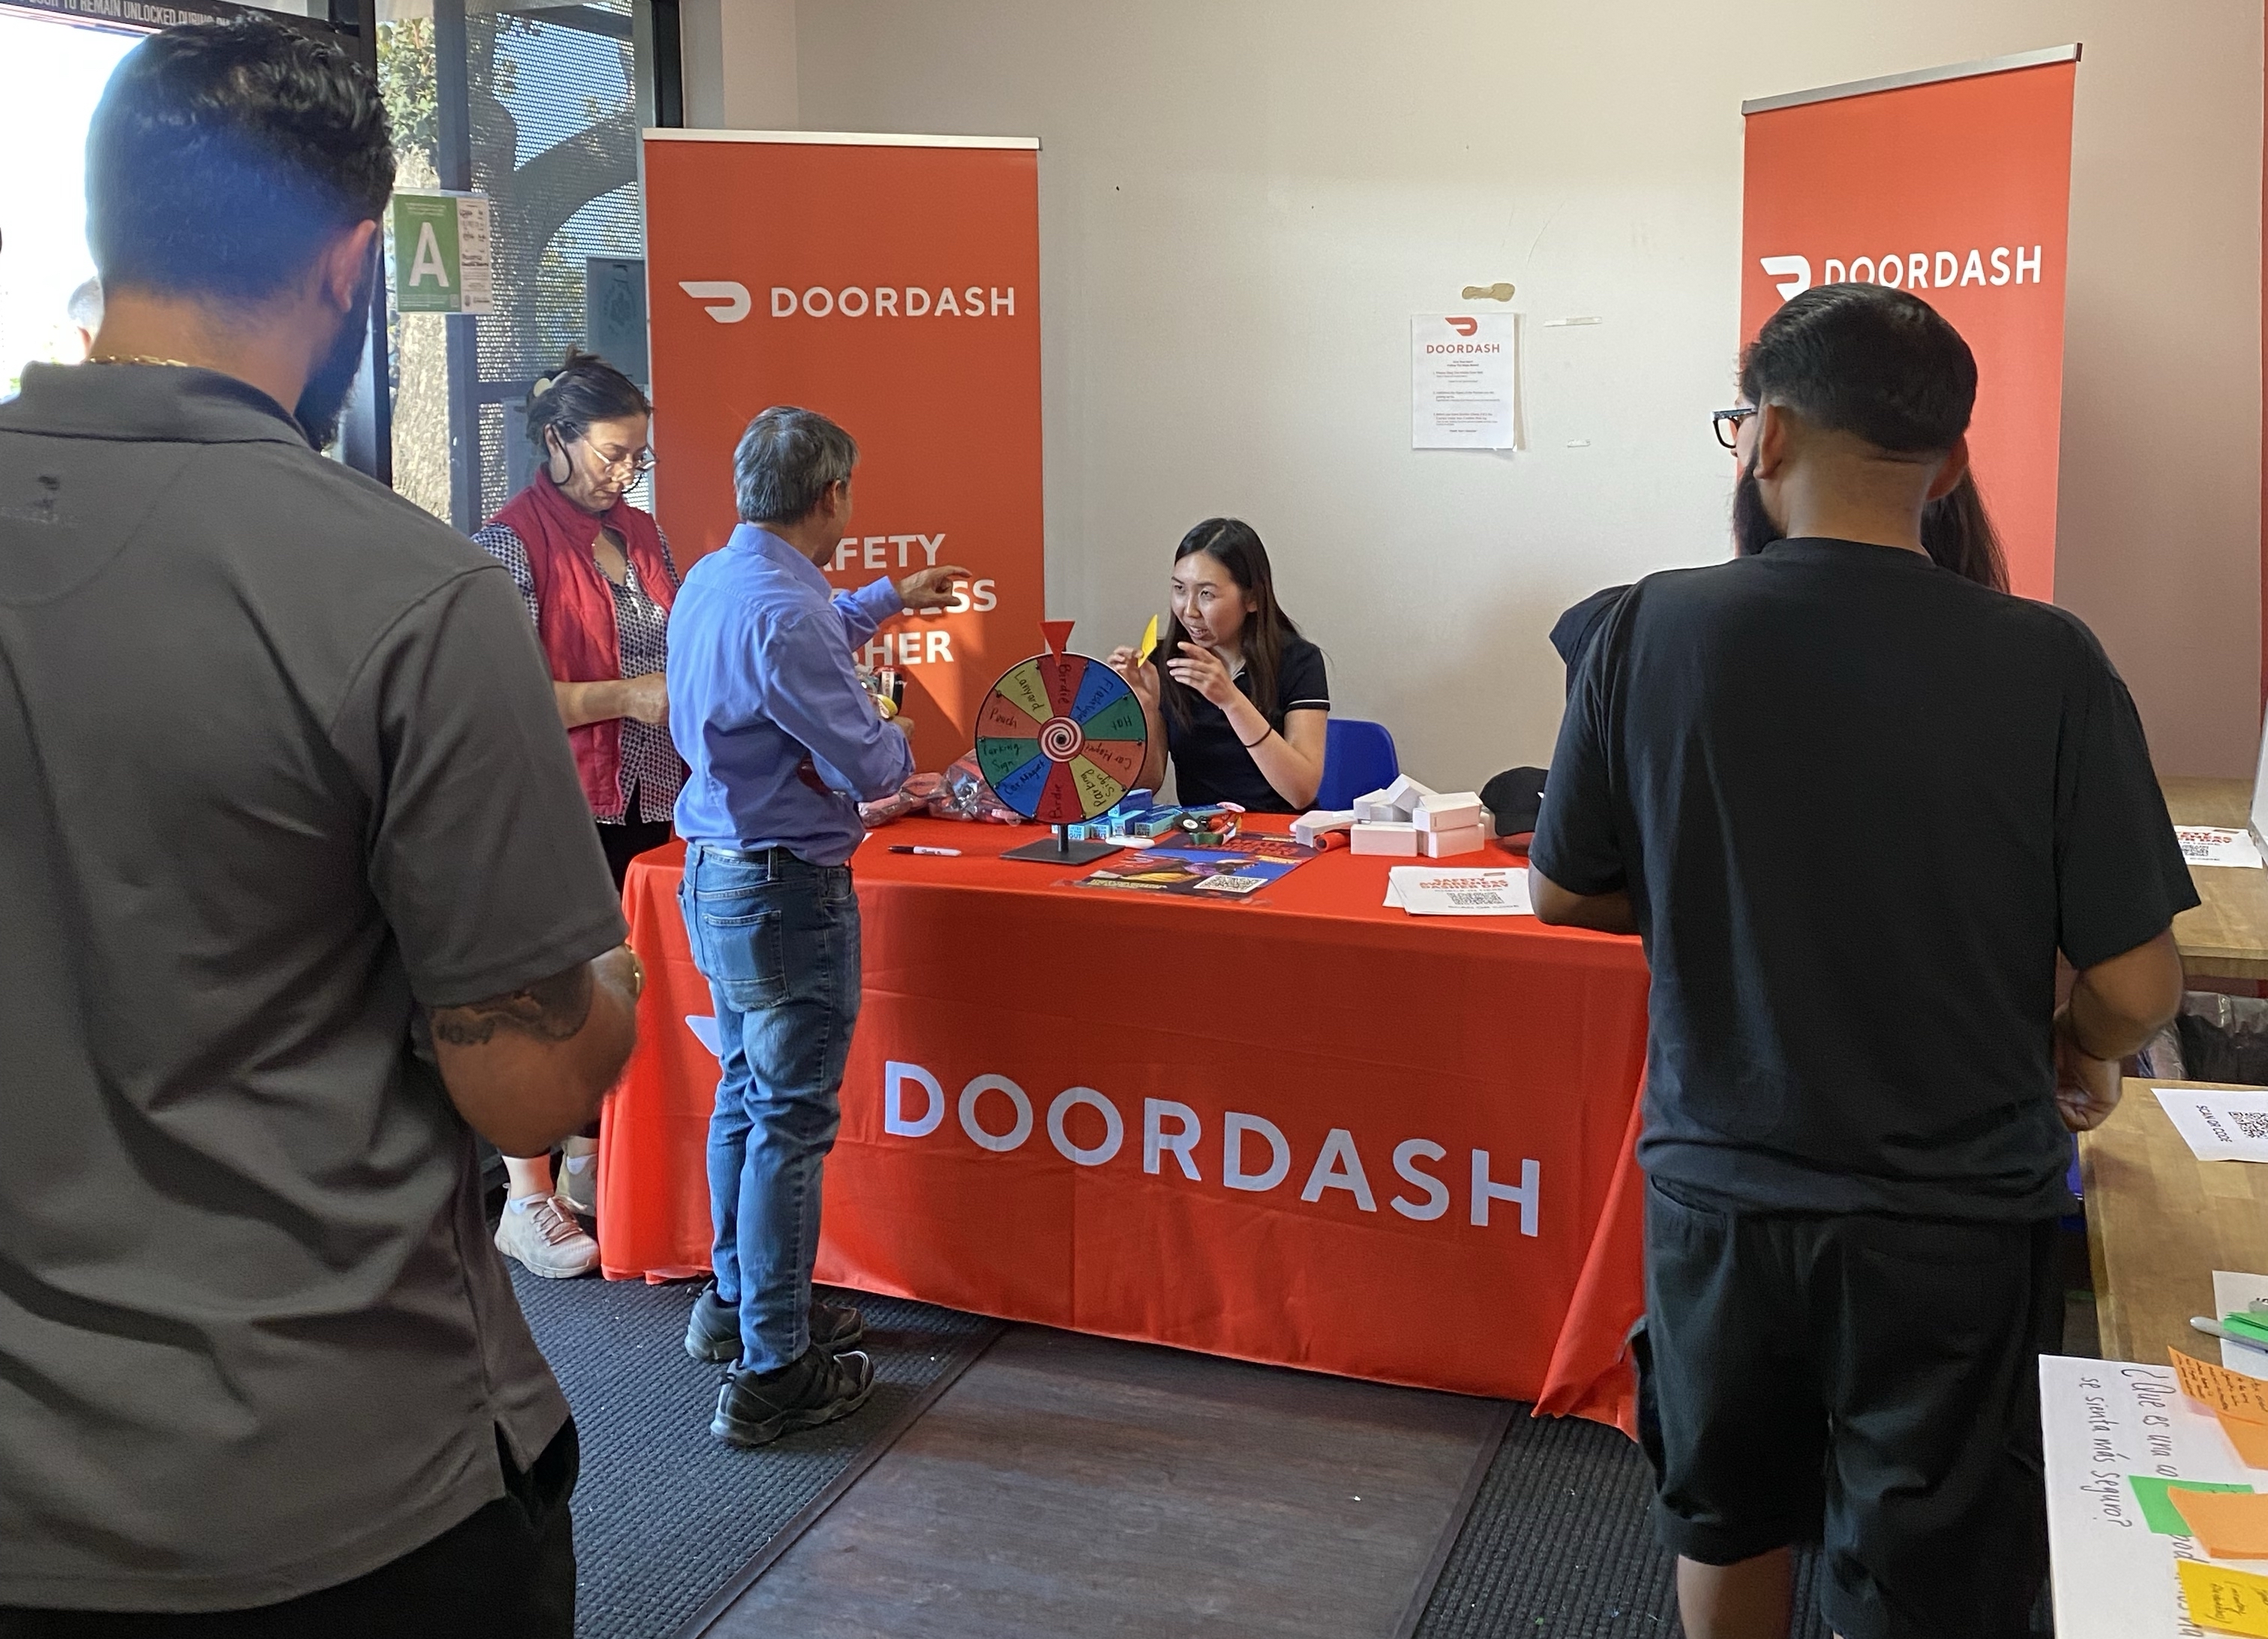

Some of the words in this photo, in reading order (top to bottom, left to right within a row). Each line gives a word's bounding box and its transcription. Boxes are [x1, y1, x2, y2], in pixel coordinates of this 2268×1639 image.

[80, 0, 122, 17] REMAIN
[123, 1, 176, 26] UNLOCKED
[409, 221, 449, 287] A
[1824, 245, 2042, 289] DOORDASH
[772, 287, 1015, 318] DOORDASH
[1426, 344, 1500, 354] DOORDASH
[823, 533, 946, 572] FETY
[853, 630, 954, 668] HER
[1014, 670, 1045, 712] Lanyard
[1112, 715, 1132, 731] Hat
[992, 759, 1015, 773] Sign
[1114, 755, 1132, 770] Car
[1081, 769, 1106, 807] Parking
[1096, 773, 1114, 797] Sign
[884, 1060, 1540, 1238] DOORDASH
[2079, 1377, 2101, 1388] se
[2085, 1397, 2120, 1432] sienta
[2142, 1415, 2170, 1427] es
[2092, 1438, 2131, 1463] más
[2146, 1434, 2172, 1457] una
